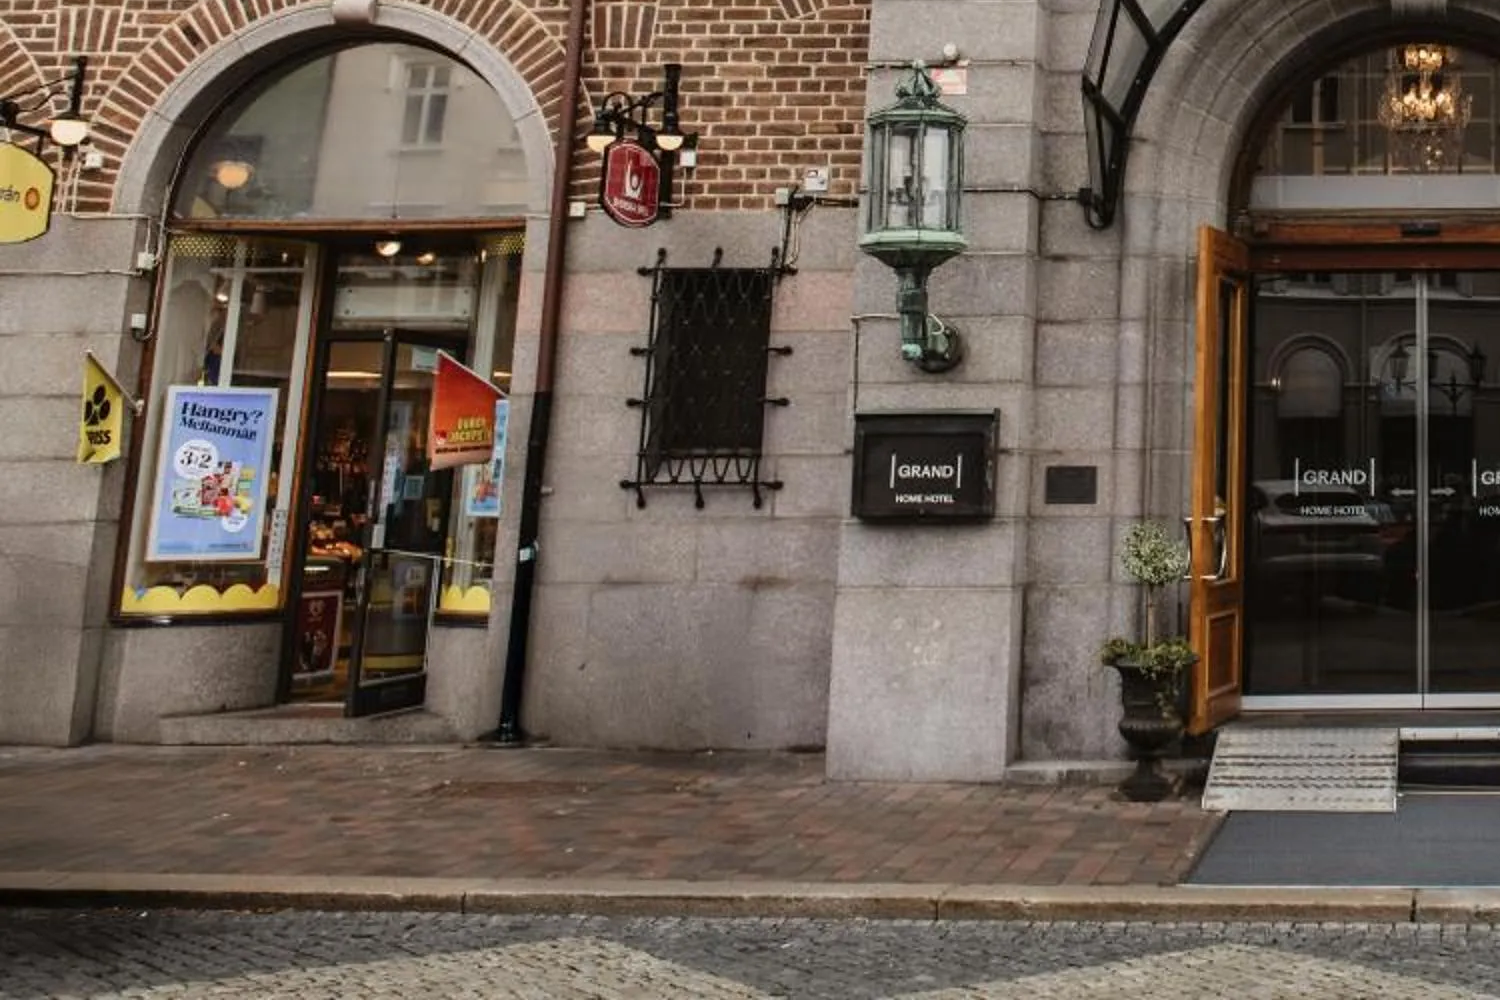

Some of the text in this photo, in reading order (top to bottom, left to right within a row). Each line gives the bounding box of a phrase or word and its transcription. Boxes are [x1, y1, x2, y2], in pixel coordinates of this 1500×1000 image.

[181, 402, 263, 426] Hangry?
[180, 451, 193, 466] 3
[198, 454, 212, 469] 2
[898, 465, 954, 478] GRAND
[1303, 470, 1367, 485] GRAND
[896, 494, 955, 504] HOME HOTEL
[1301, 505, 1366, 516] HOME HOTEL
